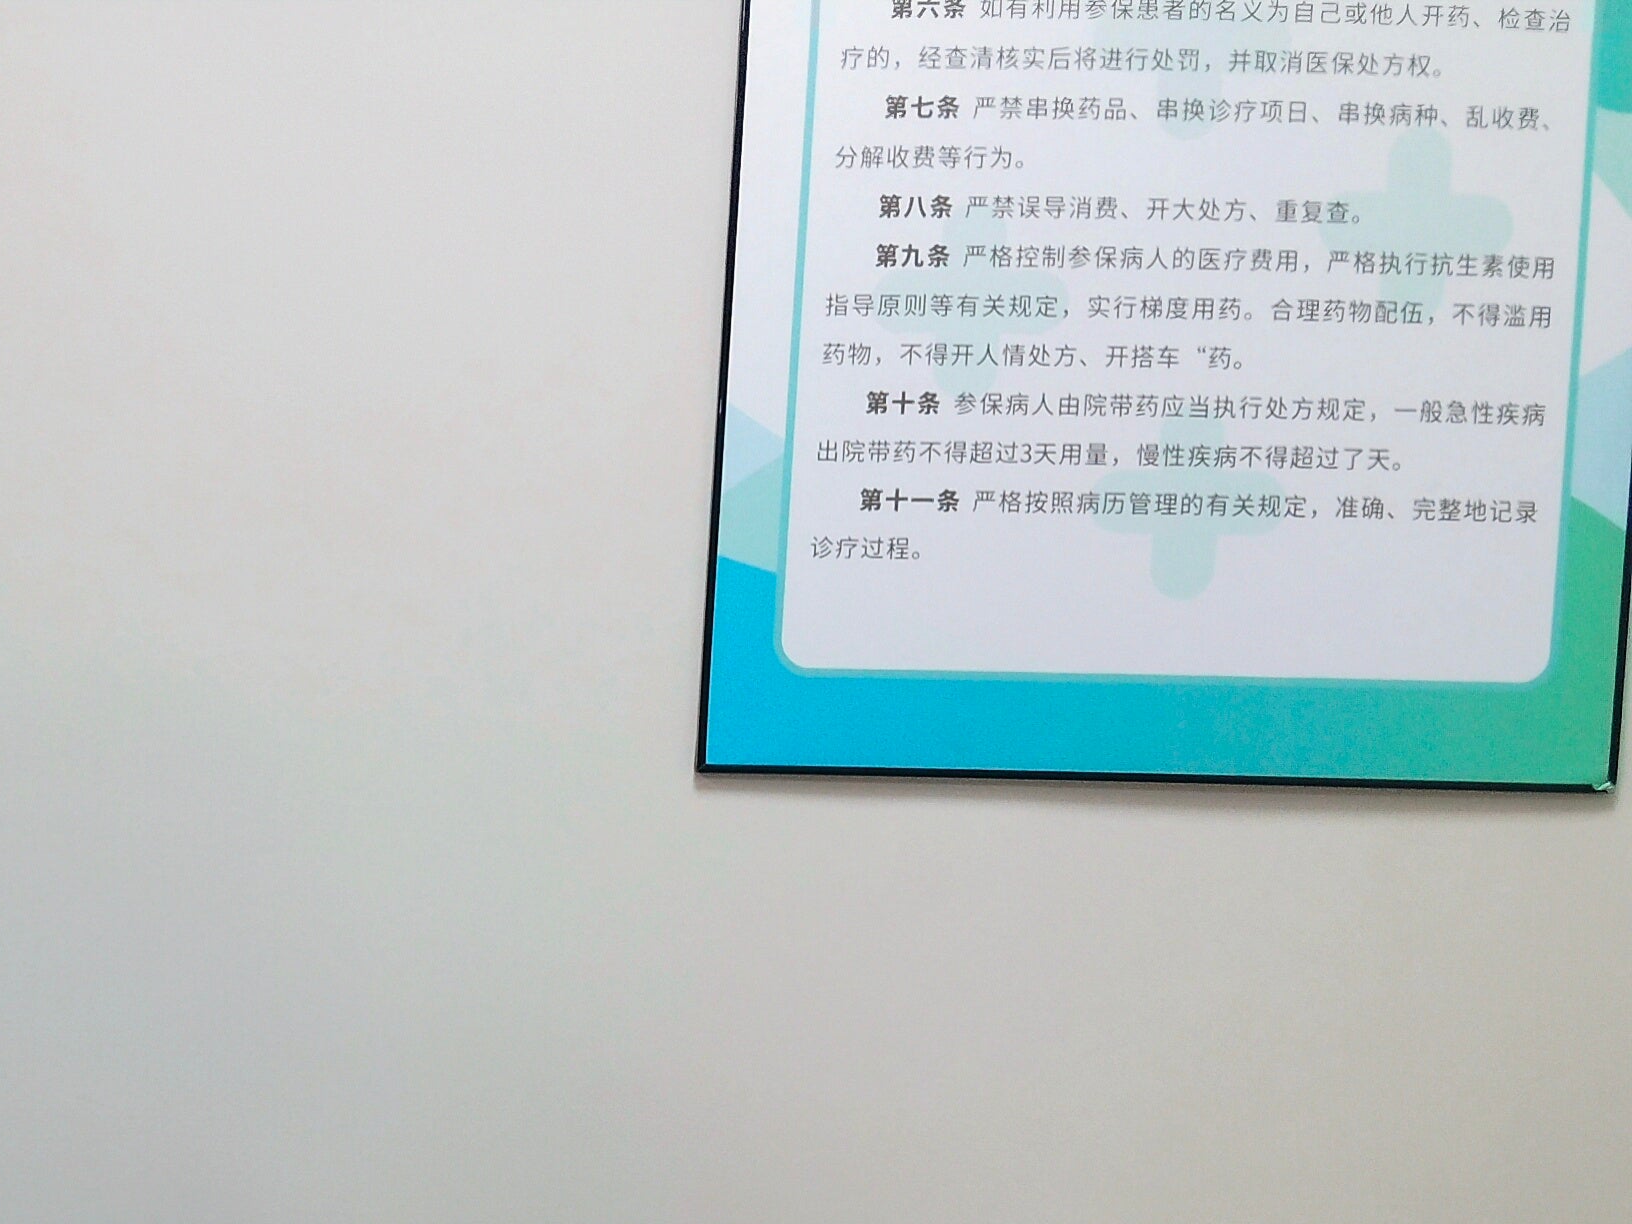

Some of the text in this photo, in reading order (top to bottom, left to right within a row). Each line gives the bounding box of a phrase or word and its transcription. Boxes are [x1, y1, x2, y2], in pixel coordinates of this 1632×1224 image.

[889, 0, 968, 20] 第六条
[839, 44, 1443, 78] 疗的，经查清核实后将进行处罚，并取消医保处方权。
[883, 94, 962, 120] 第七条
[834, 144, 1025, 170] 分解收费等行为。
[877, 193, 1361, 225] 第八条 严禁误导消费、开大处方、重复查。
[873, 243, 1556, 281] 第九条 严格控制参保病人的医疗费用，严格执行抗生素使用
[864, 390, 1548, 427] 第十条 参保病人由院带药应当执行处方规定，一般急性疾病
[816, 439, 1402, 472] 出院带药不得超过3天用量，慢性疾病不得超过了天。
[858, 487, 1539, 524] 第十一条 严格按照病历管理的有关规定，准确、完整地记录
[809, 535, 922, 561] 诊疗过程。
